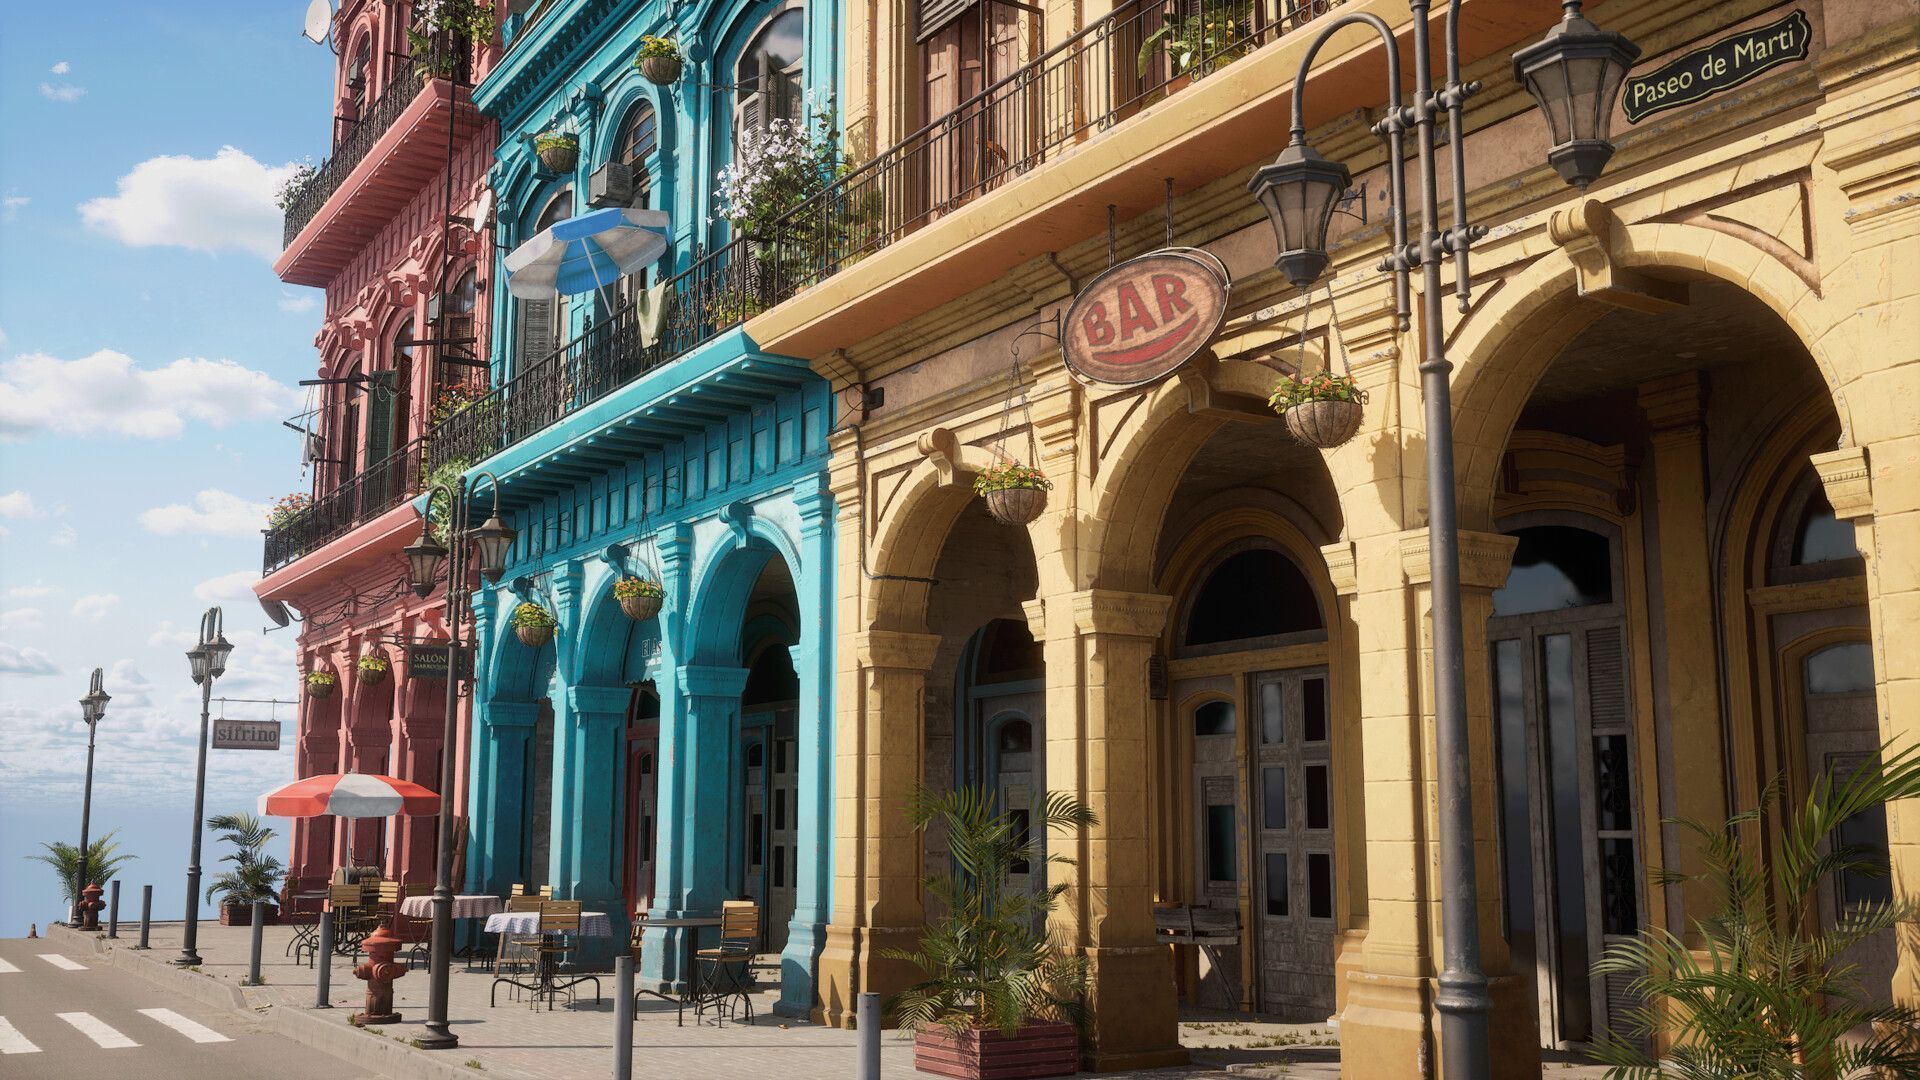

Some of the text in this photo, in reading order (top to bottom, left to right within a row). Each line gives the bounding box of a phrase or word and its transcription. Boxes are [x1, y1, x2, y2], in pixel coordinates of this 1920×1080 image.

[1633, 23, 1795, 108] Paseo de Marti
[1081, 273, 1194, 347] BAR
